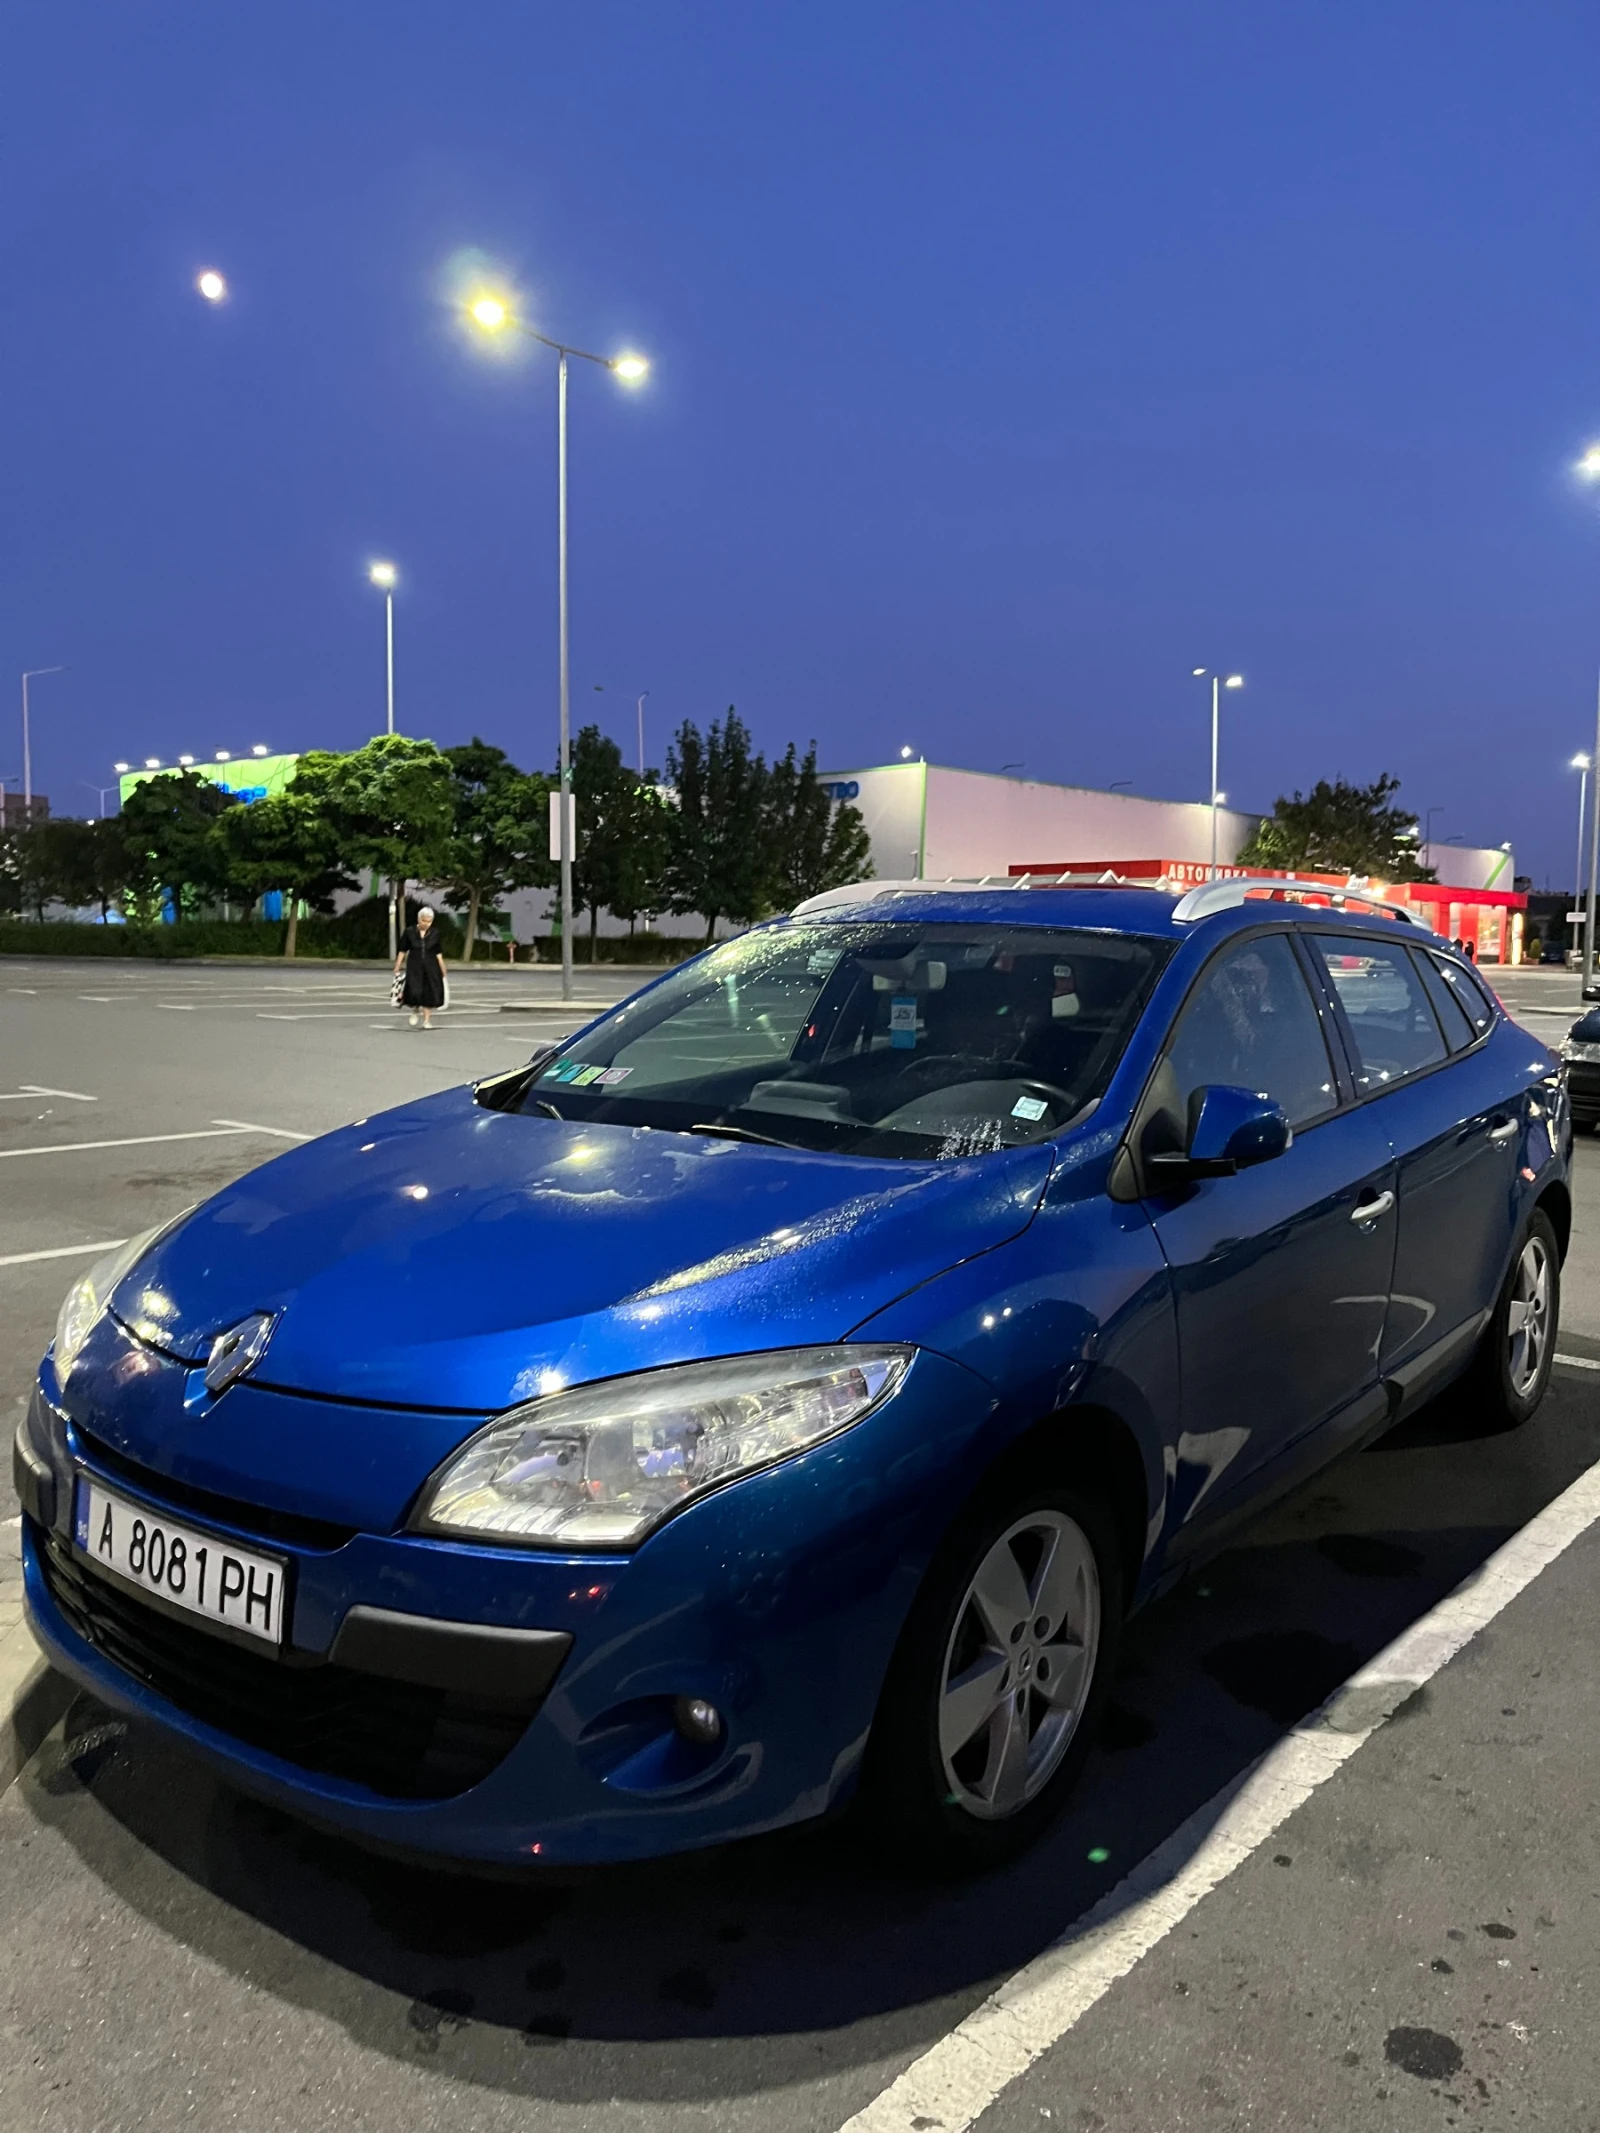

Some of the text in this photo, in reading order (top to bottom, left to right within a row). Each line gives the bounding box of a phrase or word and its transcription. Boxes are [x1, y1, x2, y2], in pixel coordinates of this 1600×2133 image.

[99, 1502, 273, 1630] A 8081 PH
